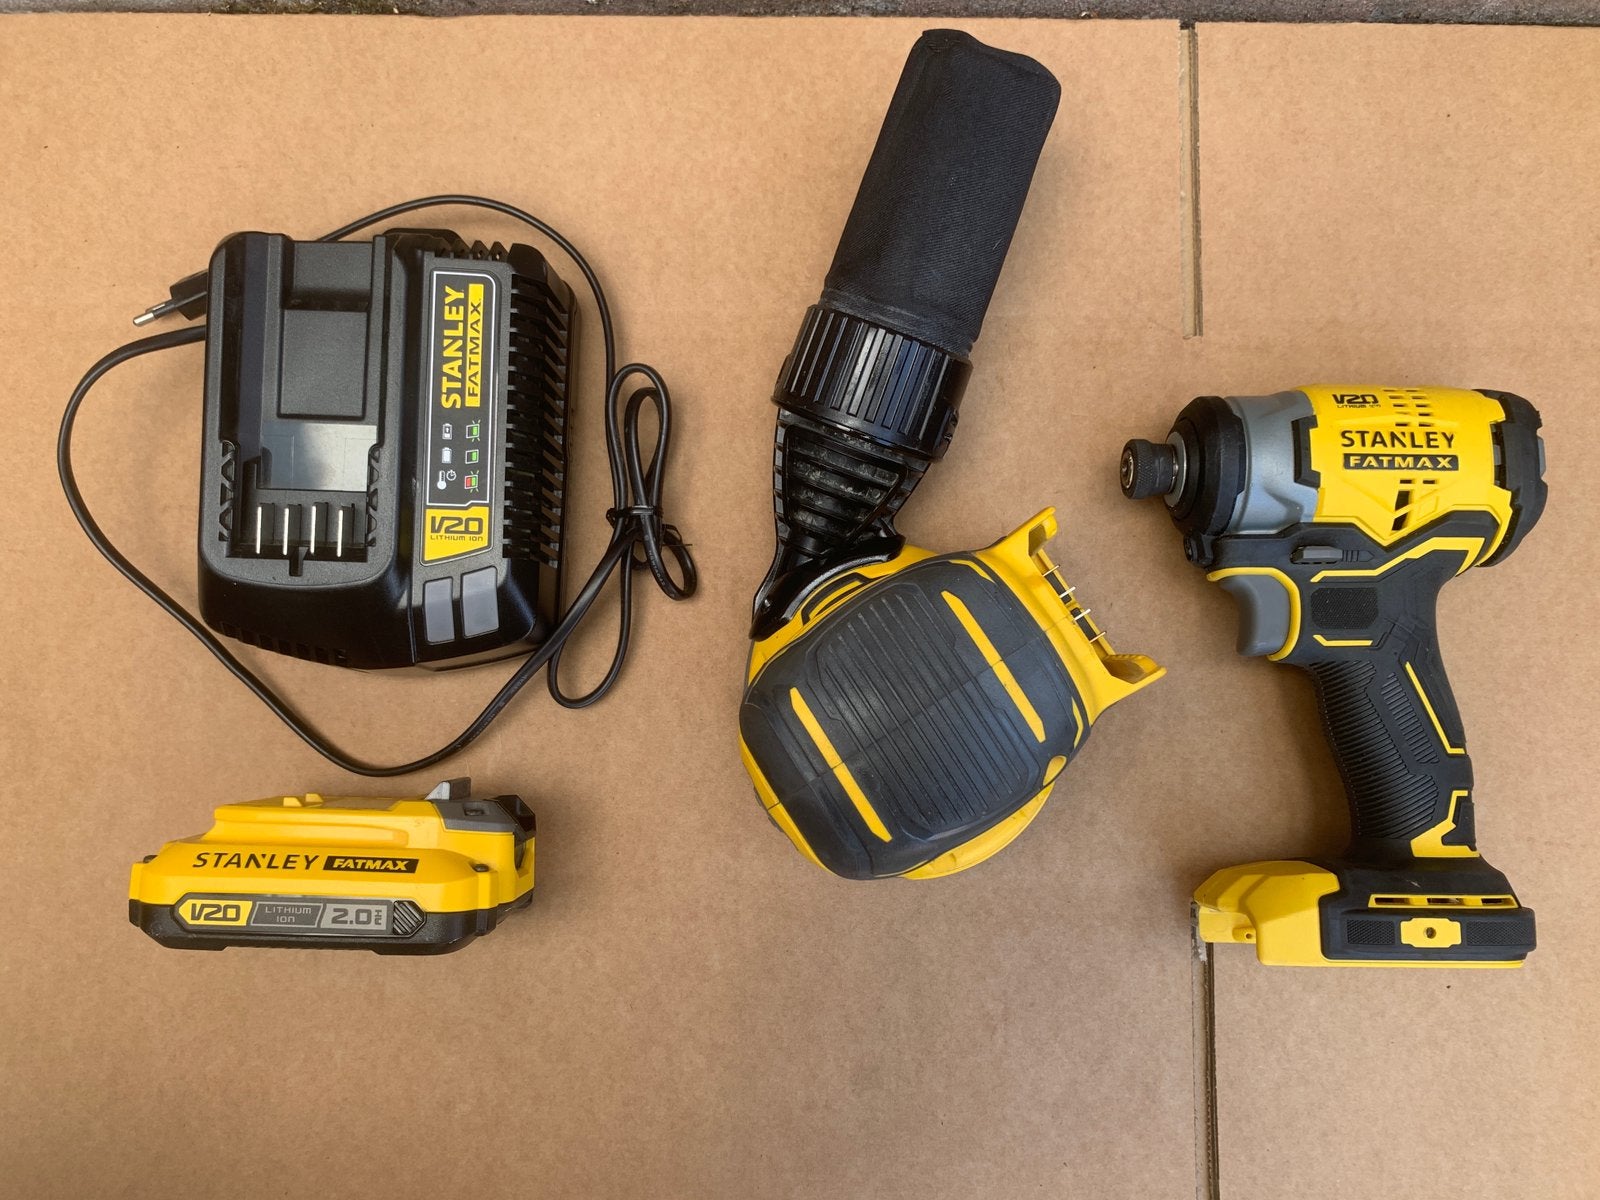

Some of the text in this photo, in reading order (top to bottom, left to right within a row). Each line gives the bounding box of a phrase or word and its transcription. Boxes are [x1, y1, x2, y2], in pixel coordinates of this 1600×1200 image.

[441, 285, 465, 409] STANLEY
[468, 301, 482, 398] FATMAX
[1332, 394, 1380, 405] V20
[1341, 430, 1454, 448] STANLEY
[1350, 456, 1453, 469] FATMAX
[430, 516, 483, 535] V20
[192, 852, 409, 871] STANLEY FATMAX
[190, 903, 241, 922] V20
[265, 906, 312, 914] LITHIUM
[331, 908, 372, 925] 2.0
